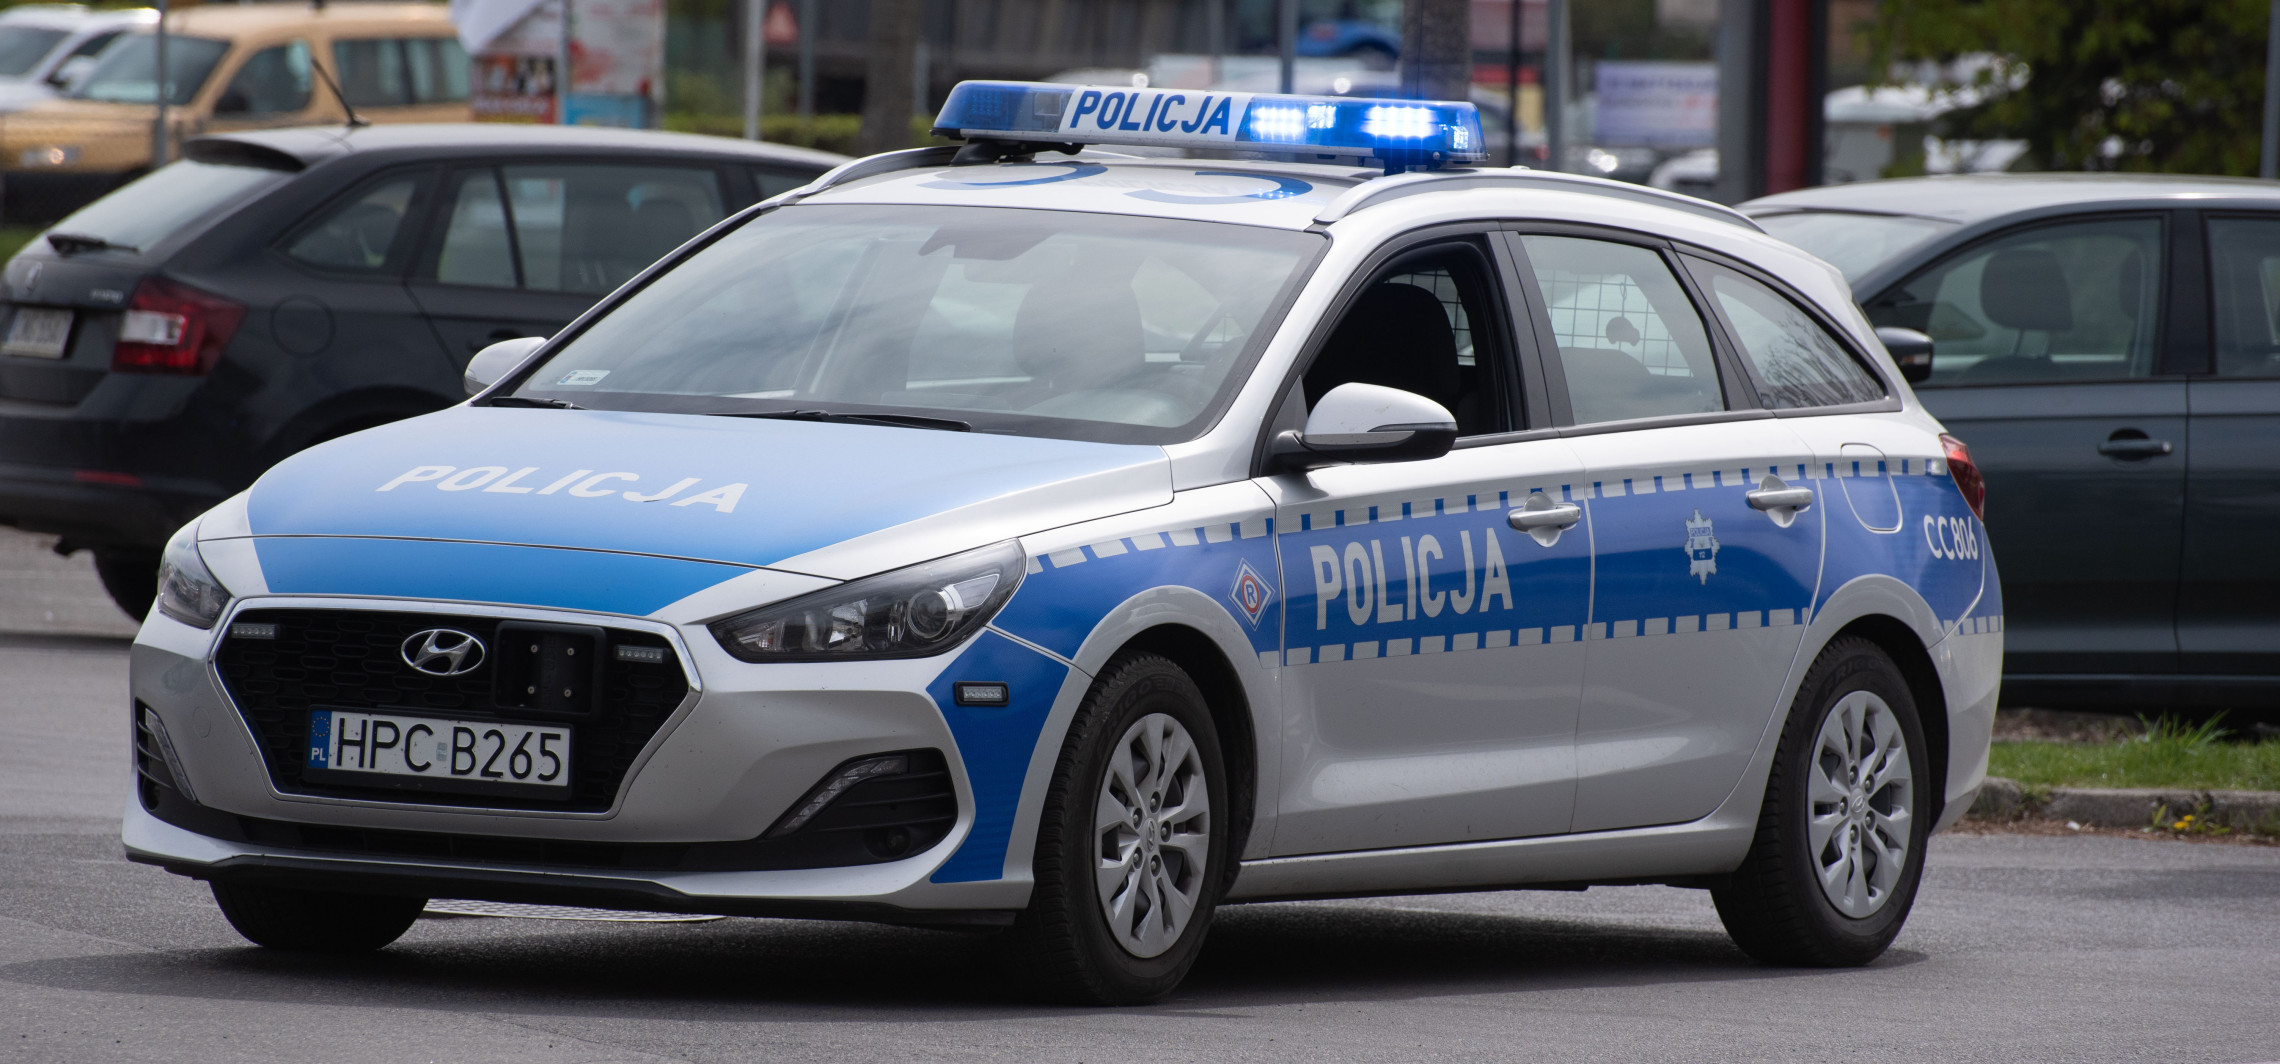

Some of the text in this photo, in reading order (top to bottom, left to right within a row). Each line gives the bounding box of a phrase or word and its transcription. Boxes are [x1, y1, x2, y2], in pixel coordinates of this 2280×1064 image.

[1069, 90, 1232, 135] POLICJA
[375, 465, 749, 514] POLICJA
[1923, 514, 1978, 561] CC806
[1245, 584, 1257, 605] R
[1310, 527, 1514, 631] POLICJA
[310, 747, 326, 762] PL
[336, 717, 561, 782] HPC B265
